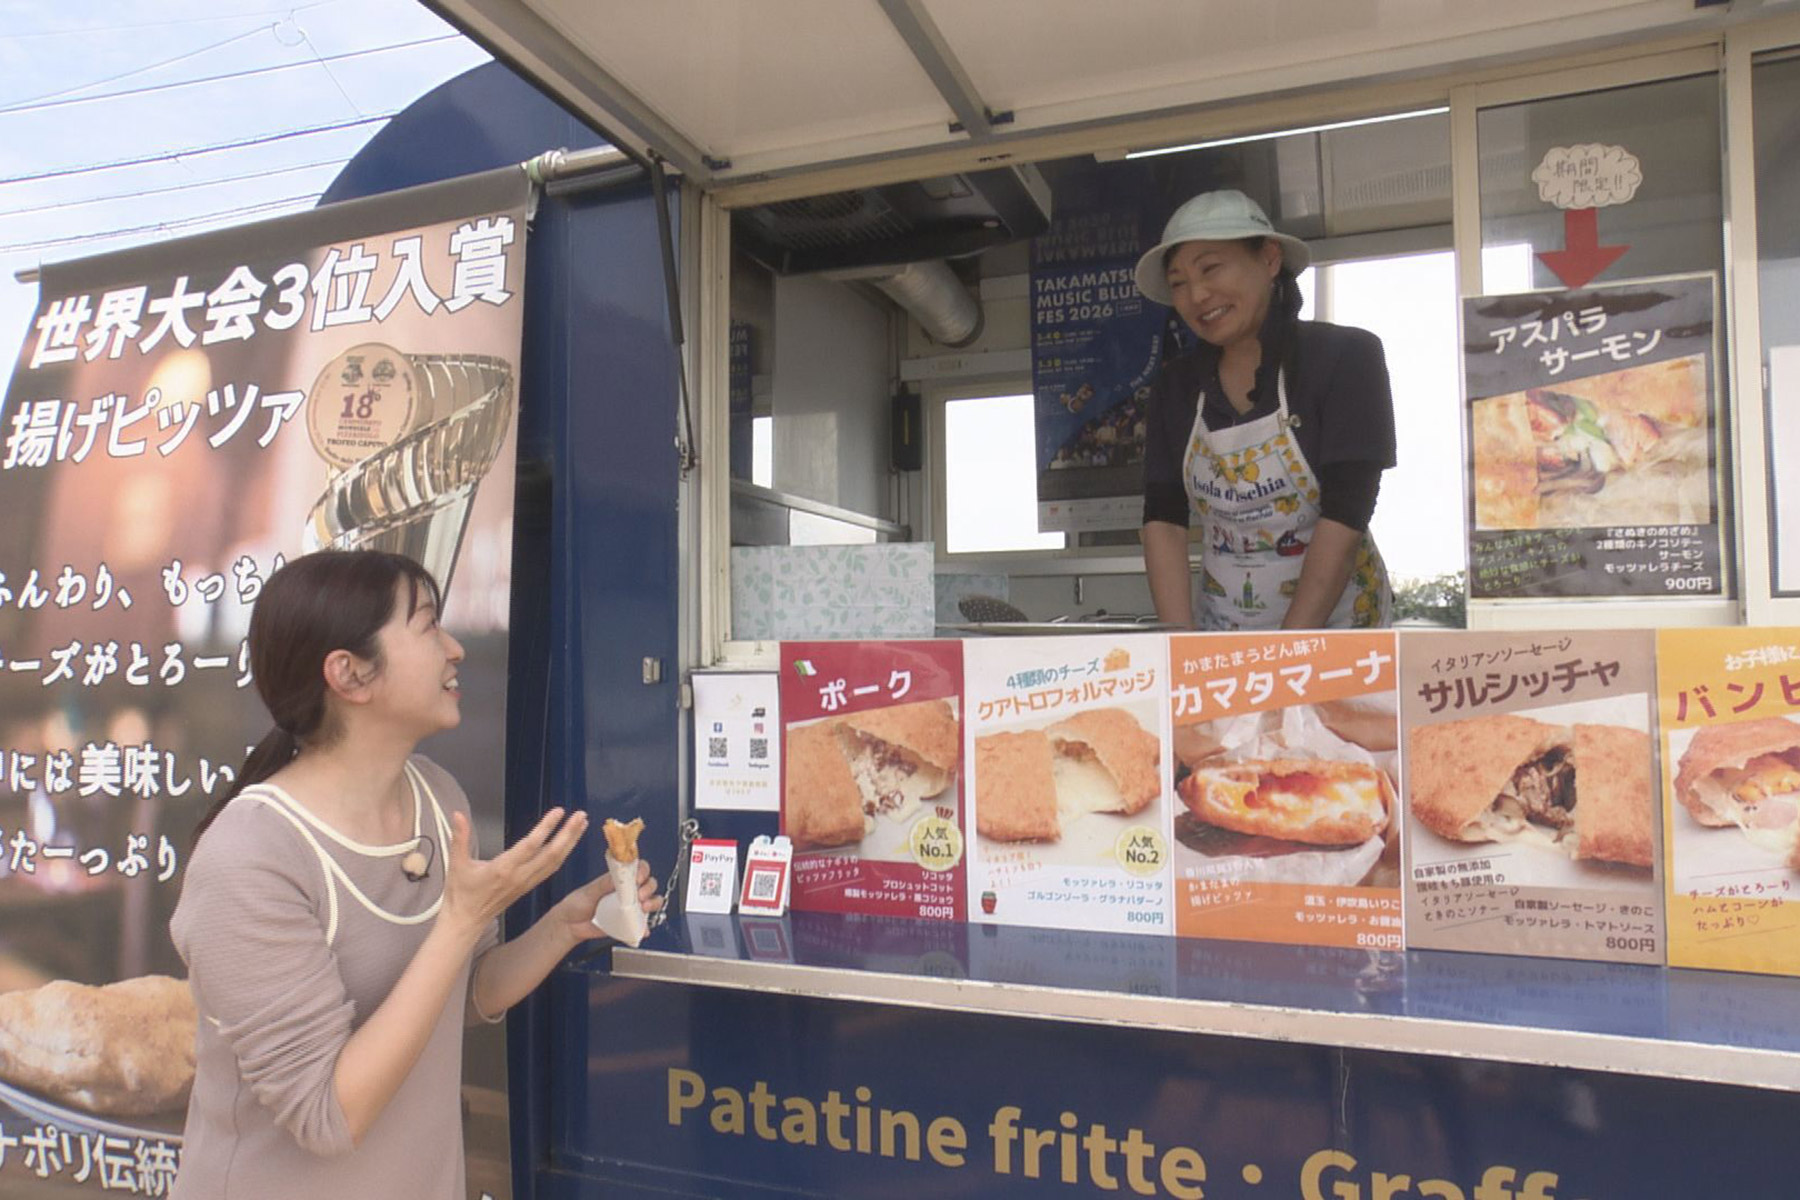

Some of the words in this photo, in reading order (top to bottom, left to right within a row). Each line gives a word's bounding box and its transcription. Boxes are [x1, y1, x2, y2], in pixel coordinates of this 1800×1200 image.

[29, 216, 515, 369] 世界大会3位入賞
[1037, 289, 1091, 309] MUSIC
[1037, 309, 1065, 324] FES
[1069, 303, 1113, 320] 2026
[1489, 306, 1607, 355] アスパラ
[1540, 330, 1661, 375] サーモン
[2, 383, 305, 470] 揚げピッツァ
[1659, 550, 1704, 561] サーモン
[0, 552, 288, 610] んわり、もっち
[1665, 576, 1712, 591] 900円
[0, 640, 254, 688] ーズがとろーり
[1431, 637, 1572, 673] イタリアンソーセージ
[819, 670, 911, 711] ポーク
[978, 669, 1155, 720] クアトロフォルマッジ
[1170, 650, 1391, 717] カマタマーナ
[1418, 658, 1620, 714] サルシッチャ
[0, 742, 255, 799] には美味しい
[920, 844, 954, 858] No.1
[923, 827, 949, 841] 人気
[1128, 836, 1154, 849] 人気
[0, 830, 177, 882] たーっぷり
[704, 853, 734, 865] PayPay
[1126, 850, 1159, 864] No.2
[919, 906, 954, 919] 800円
[1127, 912, 1164, 924] 800円
[1357, 932, 1401, 949] 800円
[1605, 937, 1656, 952] 800円
[667, 1067, 967, 1168] Patatine
[989, 1105, 1206, 1200] fritte
[0, 1121, 182, 1198] ナポリ伝統
